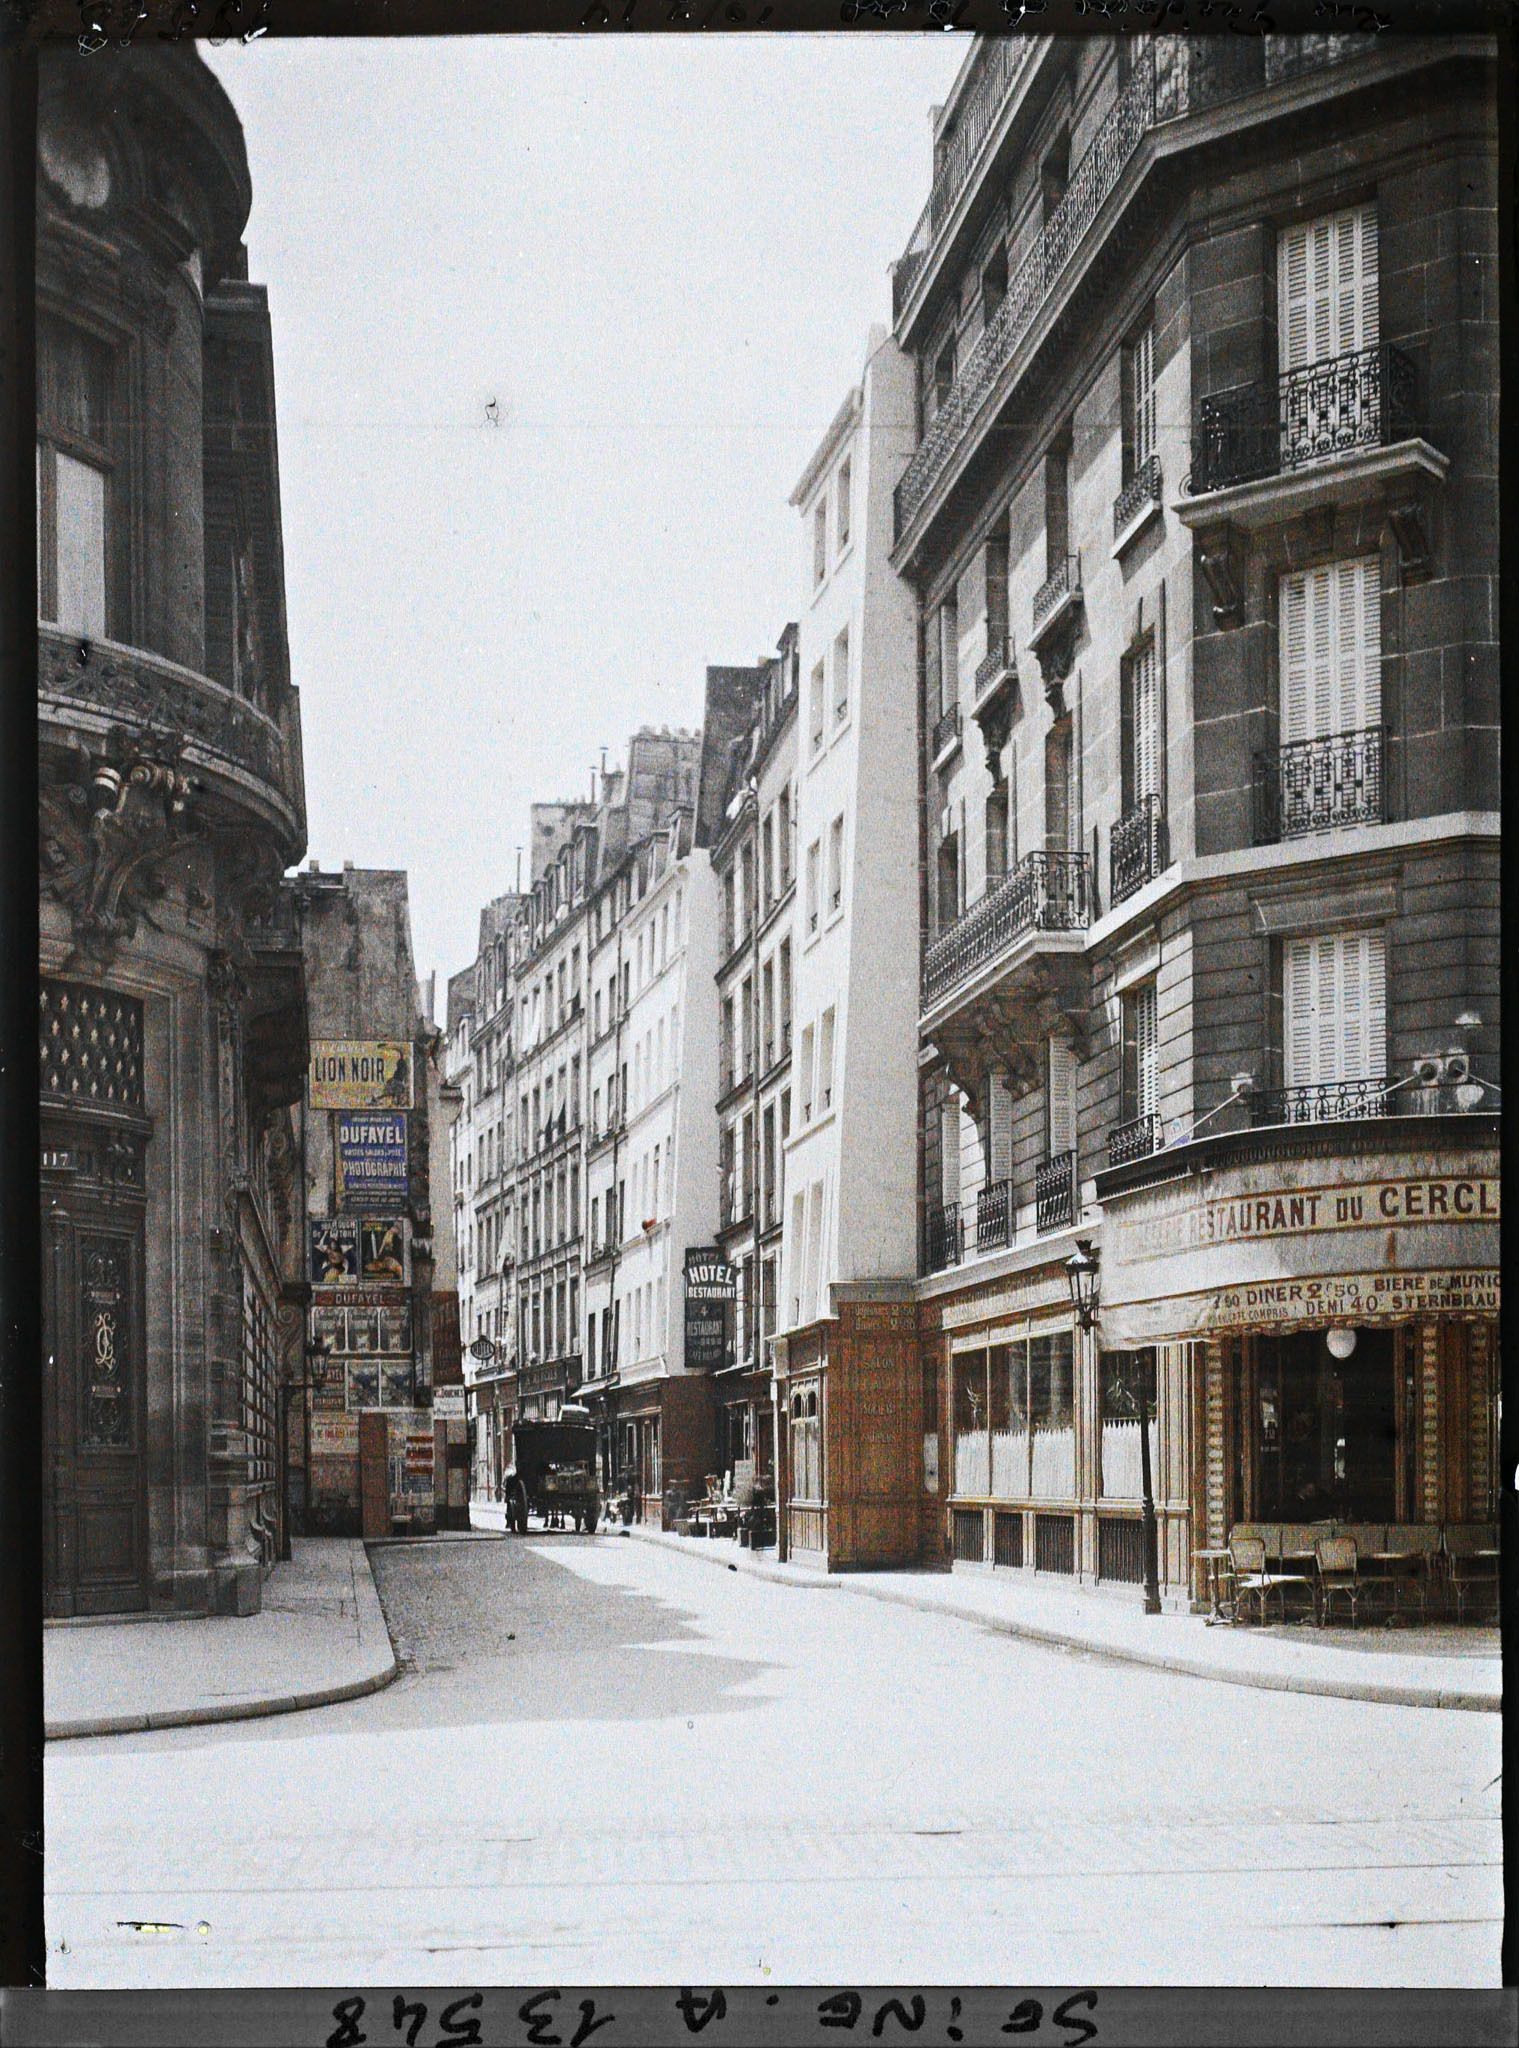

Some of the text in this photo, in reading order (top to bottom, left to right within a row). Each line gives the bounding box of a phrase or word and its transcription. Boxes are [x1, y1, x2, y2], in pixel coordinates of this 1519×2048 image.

[315, 1057, 385, 1082] LION NOIR
[340, 1126, 404, 1144] DUFAYEL
[43, 1152, 69, 1166] 117
[343, 1160, 407, 1177] PHOTOGRAPHIE
[1336, 1196, 1363, 1222] DU
[1379, 1182, 1498, 1217] CERCL
[688, 1264, 733, 1285] HOTEL
[335, 1293, 385, 1306] DUFAYEL
[688, 1286, 736, 1299] RESTAURANT
[1247, 1285, 1303, 1306] DINER
[1374, 1276, 1425, 1292] BIERE
[1429, 1278, 1444, 1290] DE
[1248, 1307, 1289, 1321] COMPRIS
[1306, 1299, 1344, 1316] DEMI
[676, 1990, 727, 2033] A
